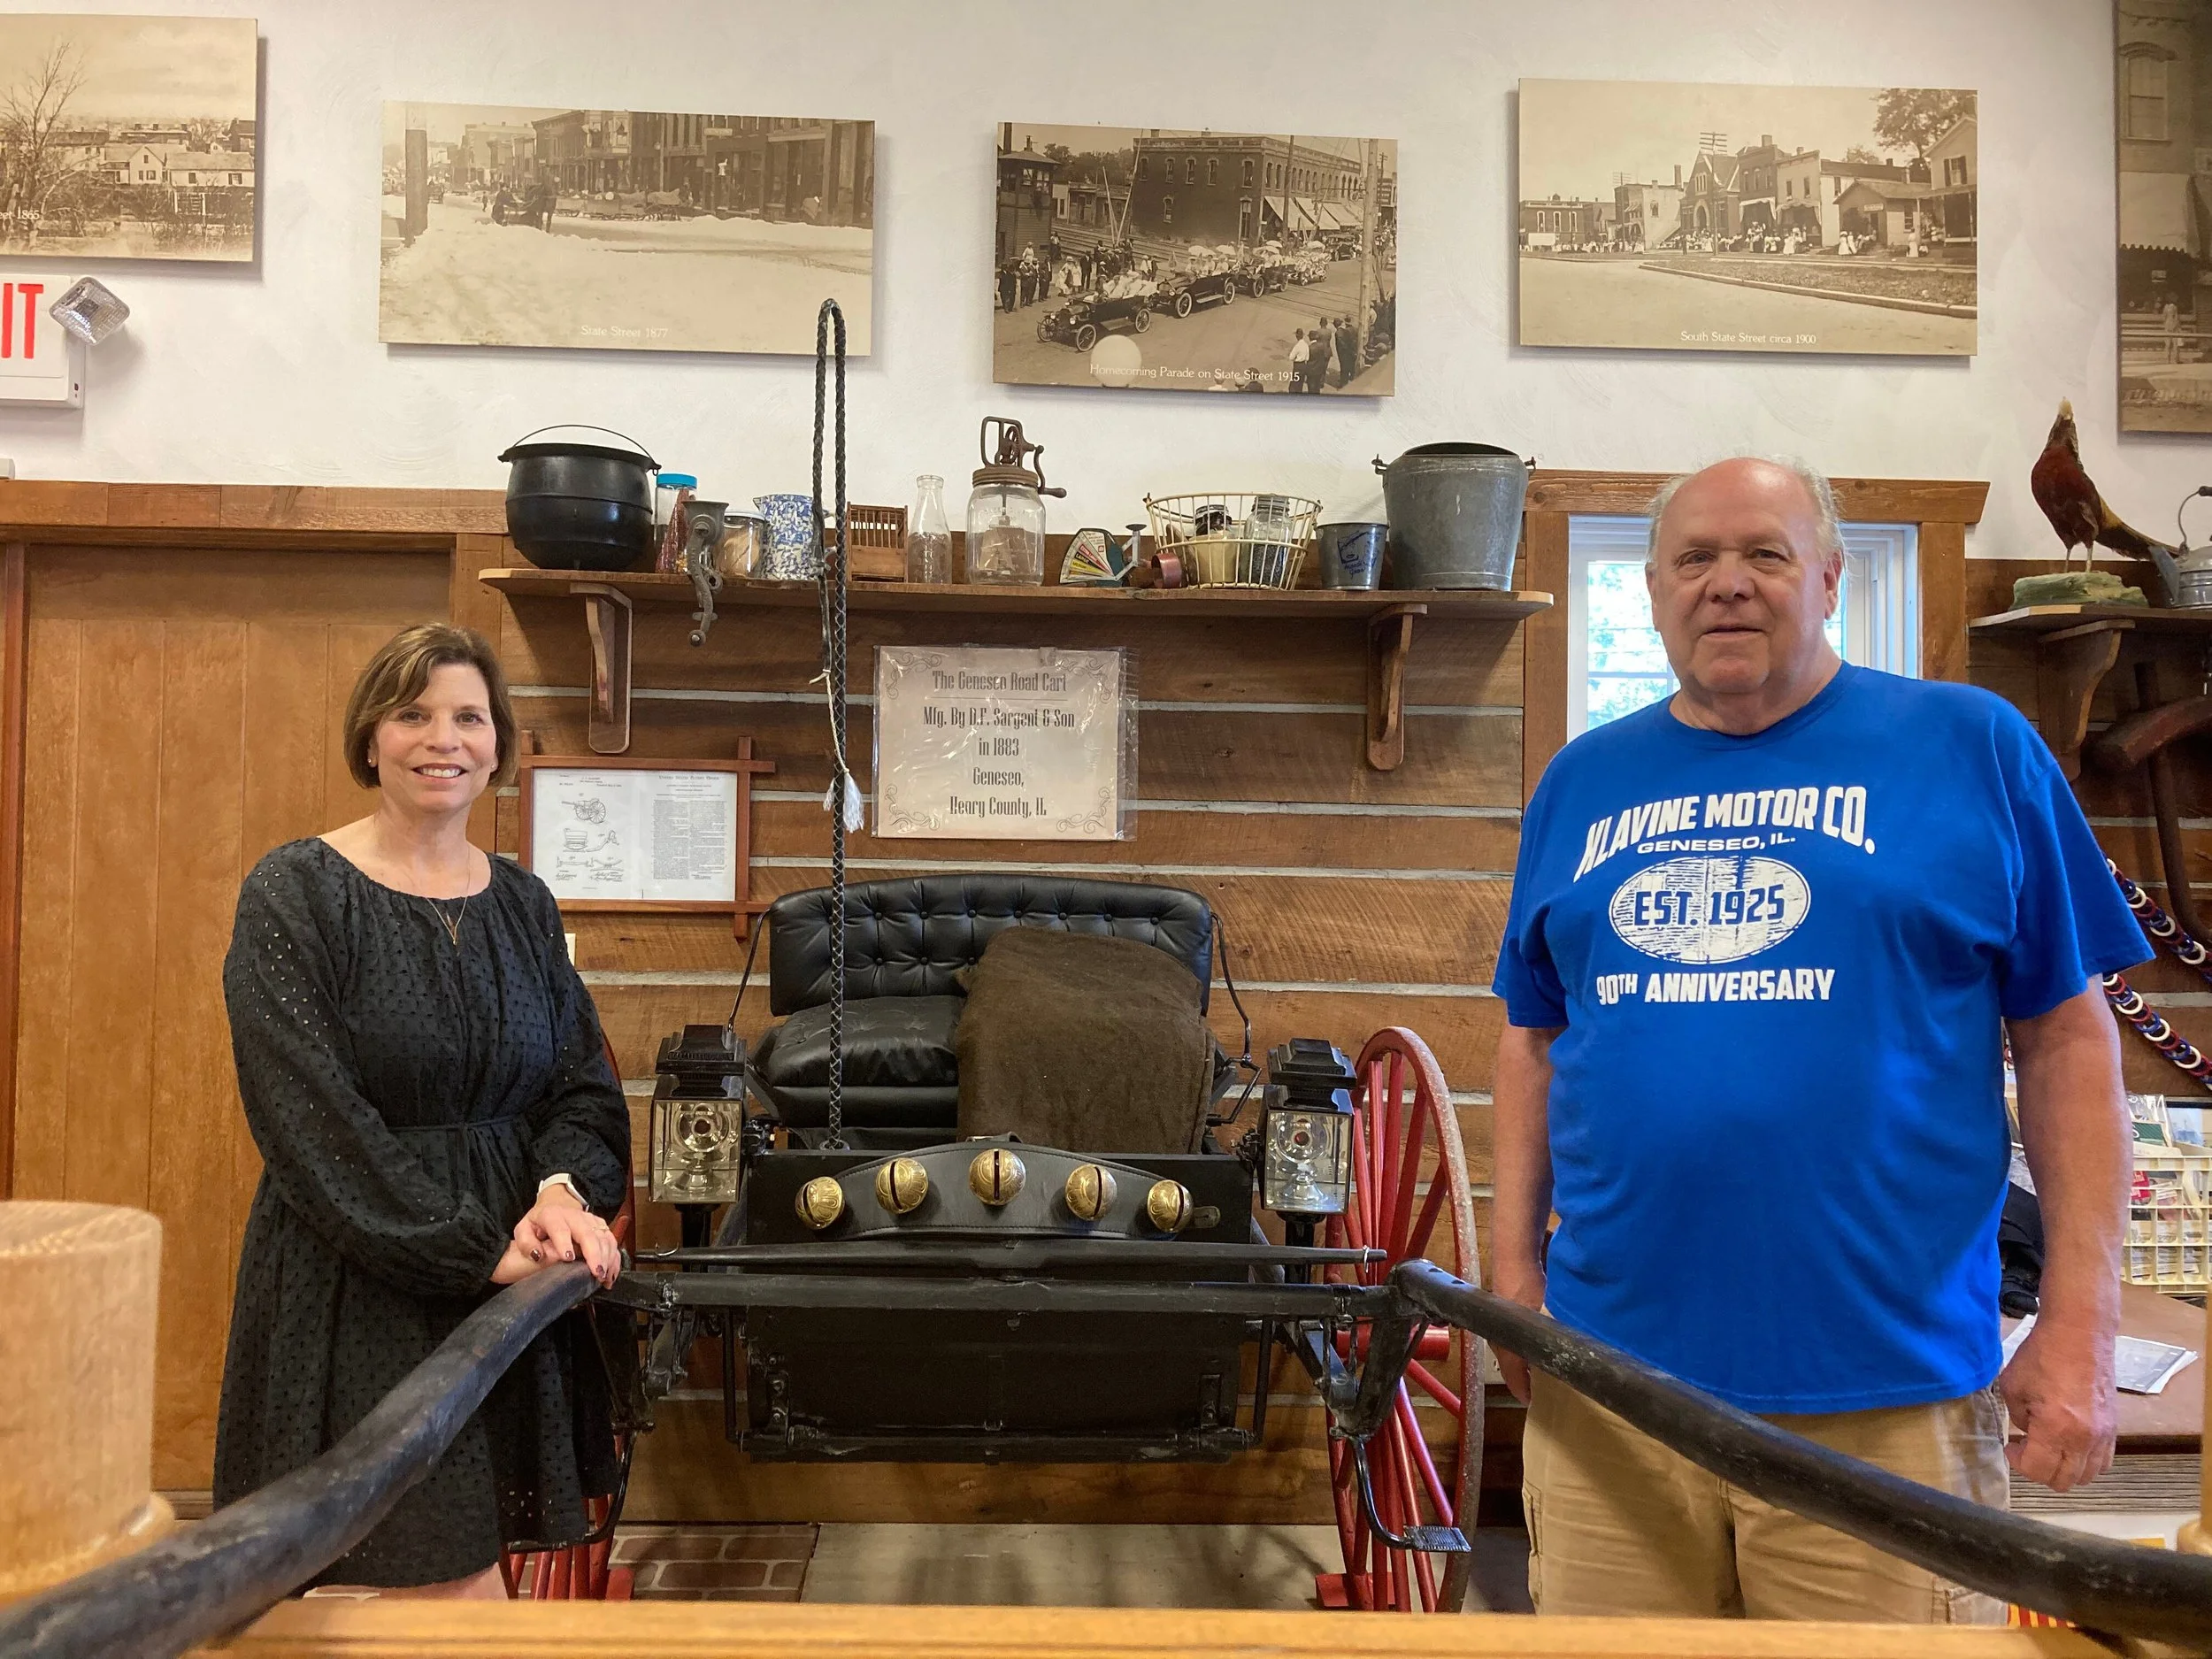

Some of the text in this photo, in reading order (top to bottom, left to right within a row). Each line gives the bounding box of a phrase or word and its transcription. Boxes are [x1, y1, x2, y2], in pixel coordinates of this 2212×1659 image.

[18, 206, 40, 219] 1865
[1, 282, 43, 359] IT
[580, 325, 669, 338] State Street 1877
[1680, 331, 1816, 344] South State Street circa 1900
[1090, 364, 1156, 378] Homecoming
[1159, 366, 1194, 378] Parade
[1214, 368, 1240, 380] State
[1243, 369, 1273, 380] Street
[1278, 371, 1300, 382] 1915
[932, 670, 1067, 692] The Geneseo Road Cart
[923, 706, 948, 728] Mfg.
[951, 707, 965, 729] By
[994, 708, 1039, 730] Sargent
[1042, 709, 1050, 727] &
[1054, 709, 1075, 727] Son
[979, 737, 1019, 757] in 1883
[972, 766, 1025, 787] Geneseo,
[988, 796, 1033, 818] County,
[1703, 787, 1820, 831] MOTOR
[1822, 786, 1876, 855] CO.
[1637, 832, 1796, 855] GENESEO, IL.
[1633, 883, 1785, 927] EST. 1925
[1596, 969, 1836, 1005] 90TH ANNIVERSARY
